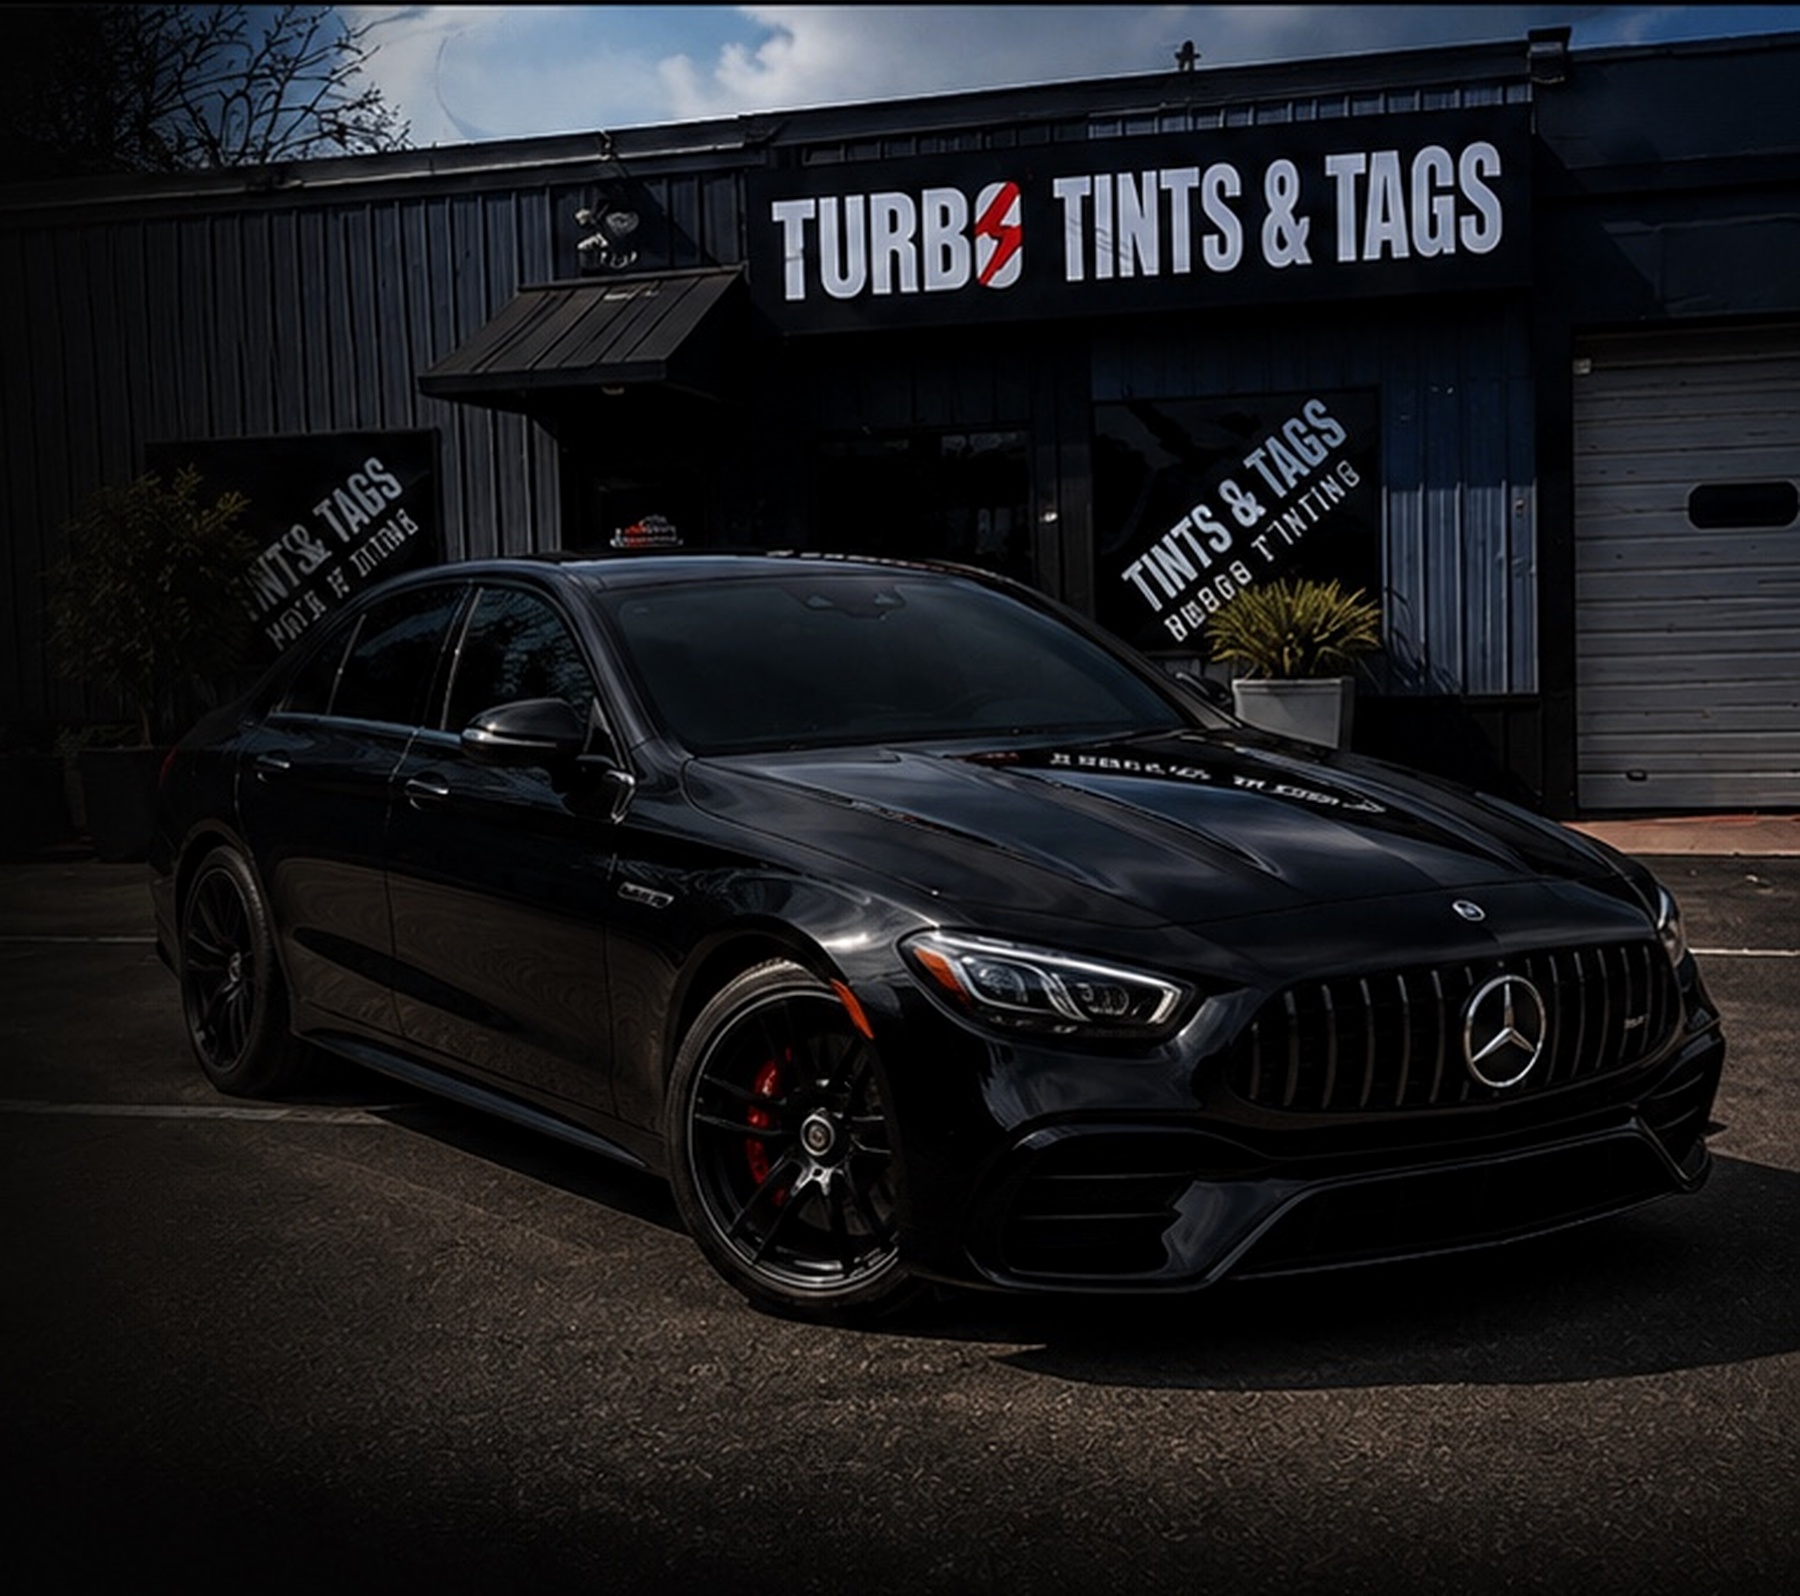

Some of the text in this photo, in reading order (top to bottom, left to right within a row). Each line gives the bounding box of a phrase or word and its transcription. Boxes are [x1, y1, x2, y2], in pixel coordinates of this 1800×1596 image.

[771, 141, 1502, 302] TURBO TINTS & TAGS
[312, 456, 404, 543] TAGS
[1121, 503, 1233, 612] TINTS
[1218, 478, 1267, 528] &
[1243, 398, 1348, 498] TAGS
